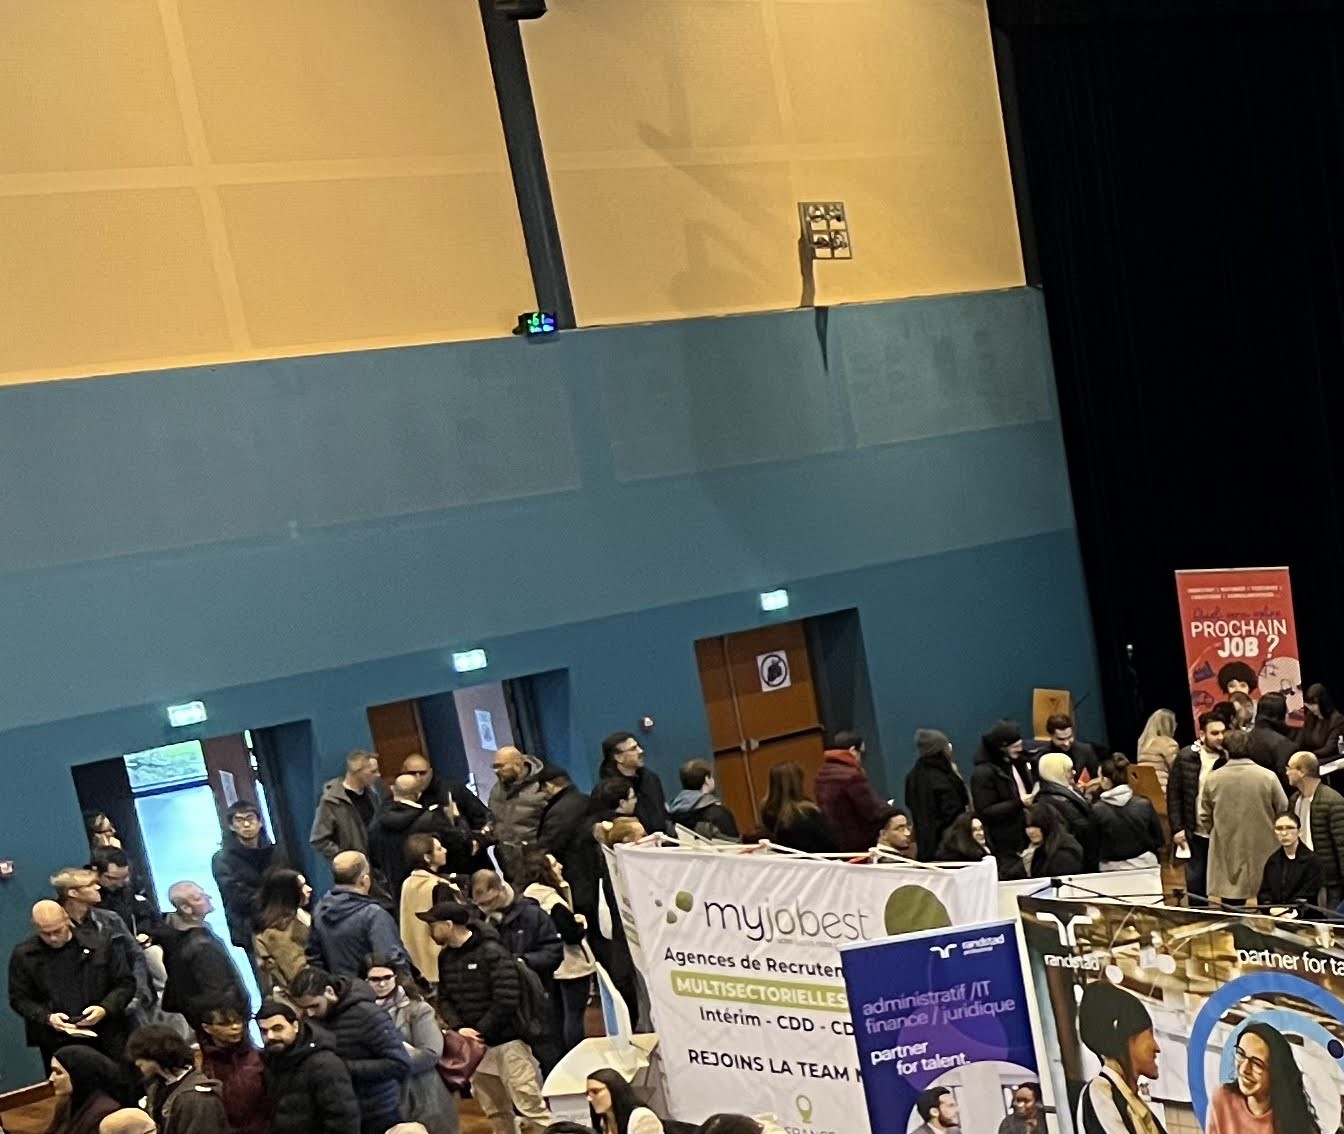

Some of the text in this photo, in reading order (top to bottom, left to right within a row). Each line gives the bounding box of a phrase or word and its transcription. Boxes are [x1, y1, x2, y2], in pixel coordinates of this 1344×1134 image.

[1190, 618, 1287, 638] PROCHAIN
[1218, 634, 1280, 658] JOB ?
[704, 897, 874, 942] myjobest
[664, 947, 735, 966] Agences
[741, 954, 761, 971] de
[1044, 953, 1102, 971] randstad
[1236, 947, 1300, 974] partner
[1303, 952, 1329, 974] for
[676, 977, 847, 1007] MULTISECTORIELLES
[863, 983, 966, 1016] administratif
[700, 1006, 855, 1035] Intérim CDD CD
[865, 999, 1015, 1034] finance / juridique
[688, 1049, 764, 1071] REJOINS
[769, 1059, 793, 1075] LA
[797, 1061, 849, 1081] TEAM
[871, 1042, 928, 1065] partner
[896, 1052, 970, 1075] for talent.
